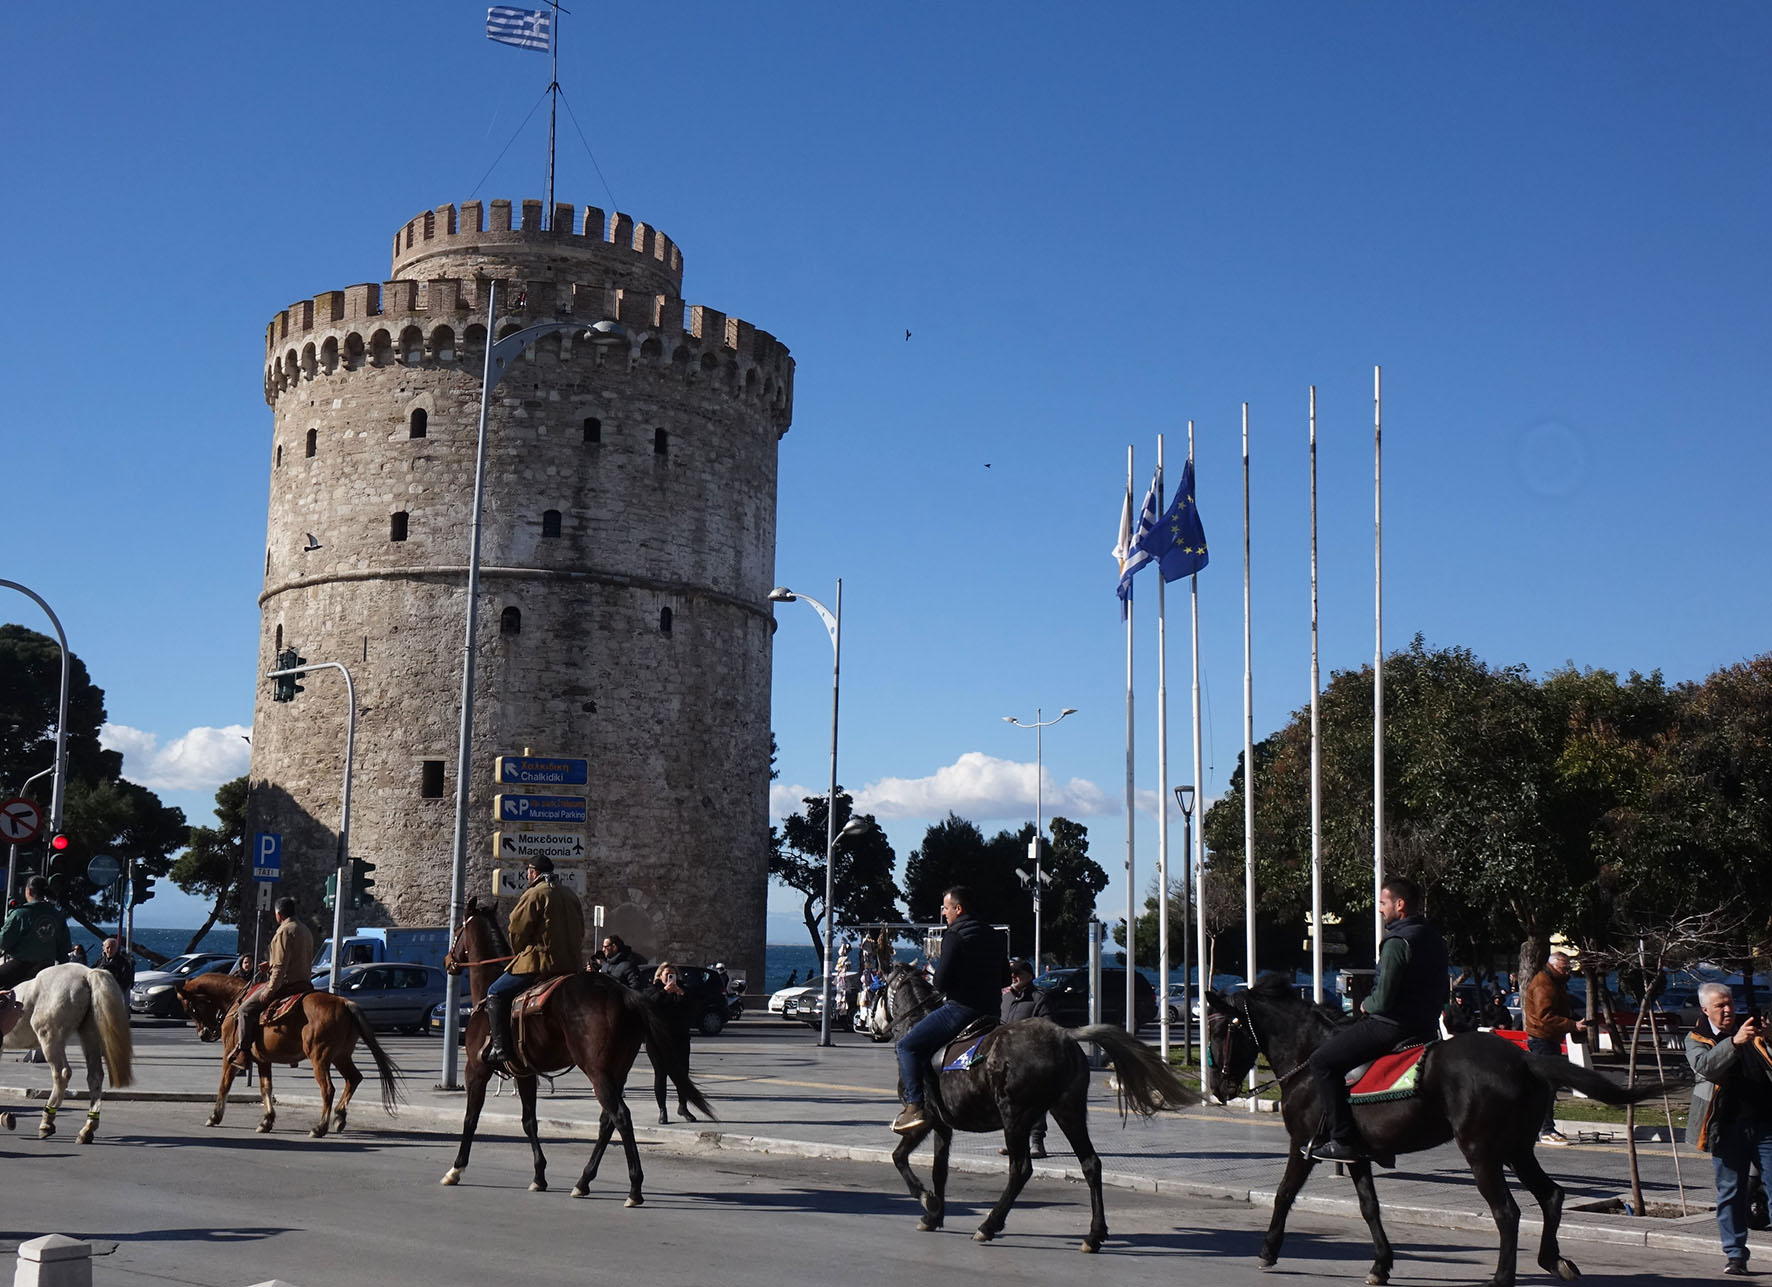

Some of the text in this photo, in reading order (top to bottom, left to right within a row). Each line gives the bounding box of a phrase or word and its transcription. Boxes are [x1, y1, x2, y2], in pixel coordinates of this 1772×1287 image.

[521, 771, 564, 782] Chalkidiki
[519, 799, 529, 816] P
[529, 809, 586, 821] Municipal Parking
[518, 834, 573, 844] Μακεδονία
[261, 835, 276, 865] P
[518, 846, 571, 856] Macedonia
